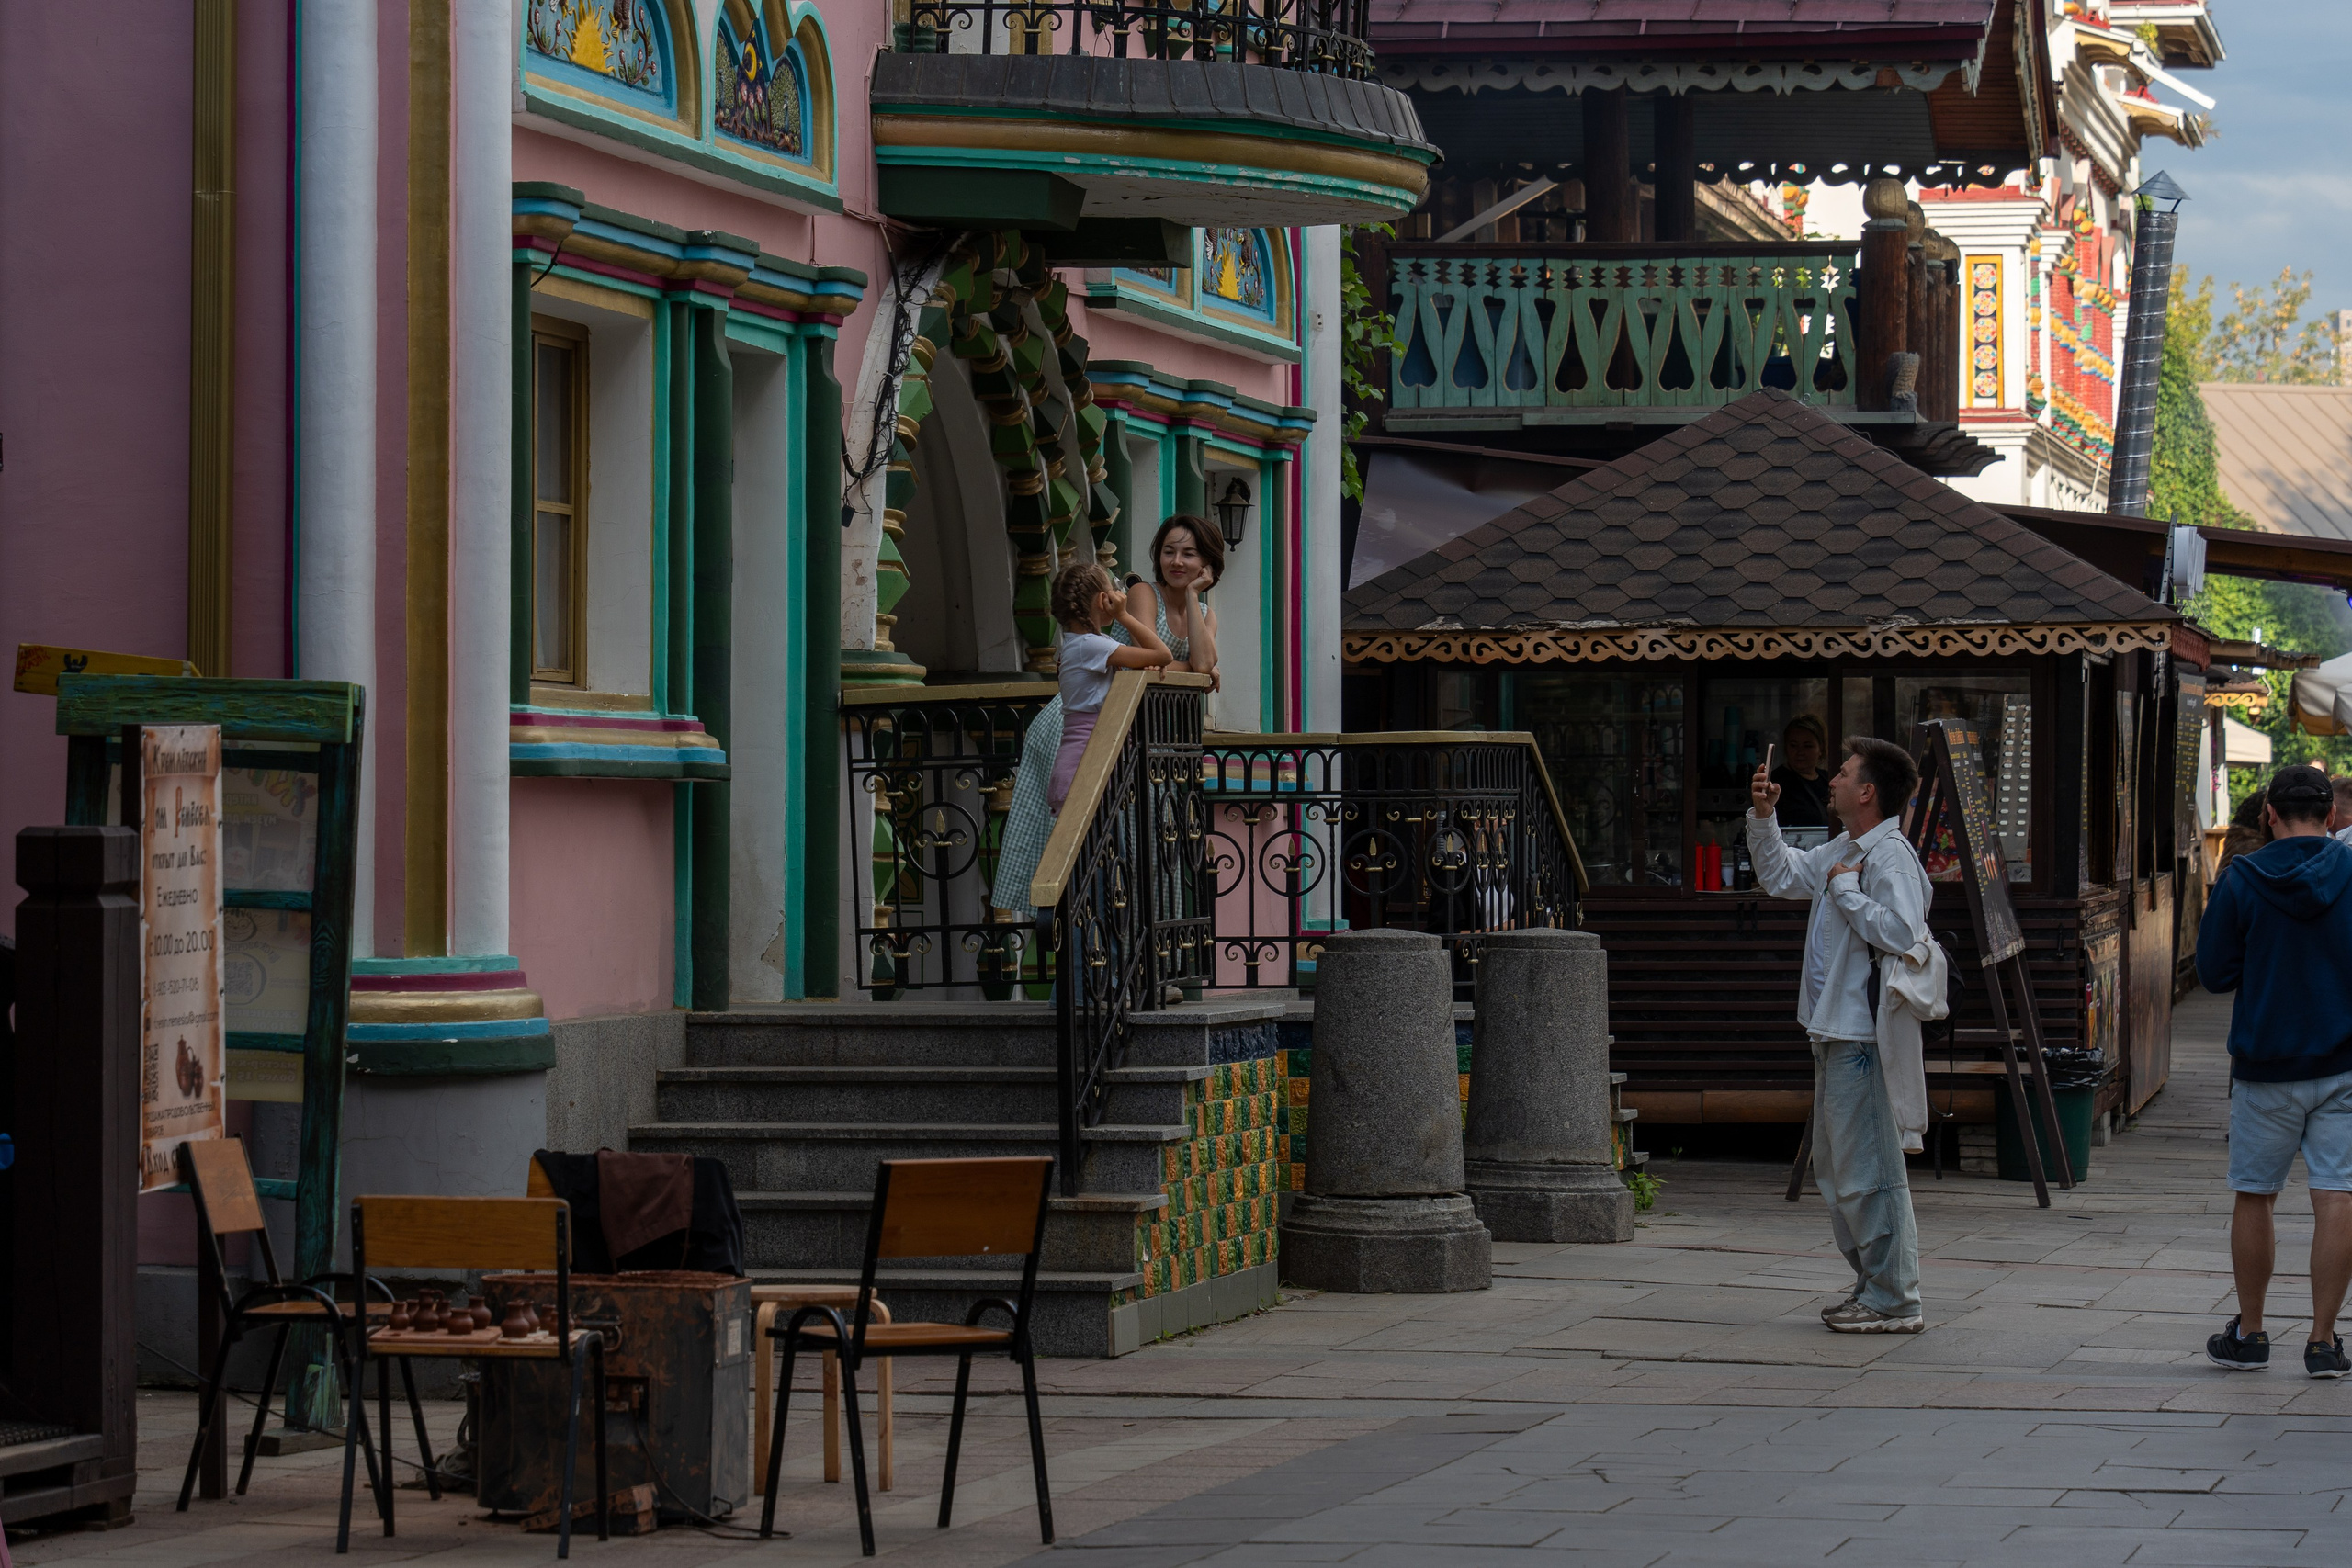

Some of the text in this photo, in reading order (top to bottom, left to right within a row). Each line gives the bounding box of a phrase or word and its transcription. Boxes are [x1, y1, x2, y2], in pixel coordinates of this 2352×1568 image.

[153, 933, 173, 957] 10.00
[174, 938, 185, 956] до
[186, 930, 215, 953] 20.00
